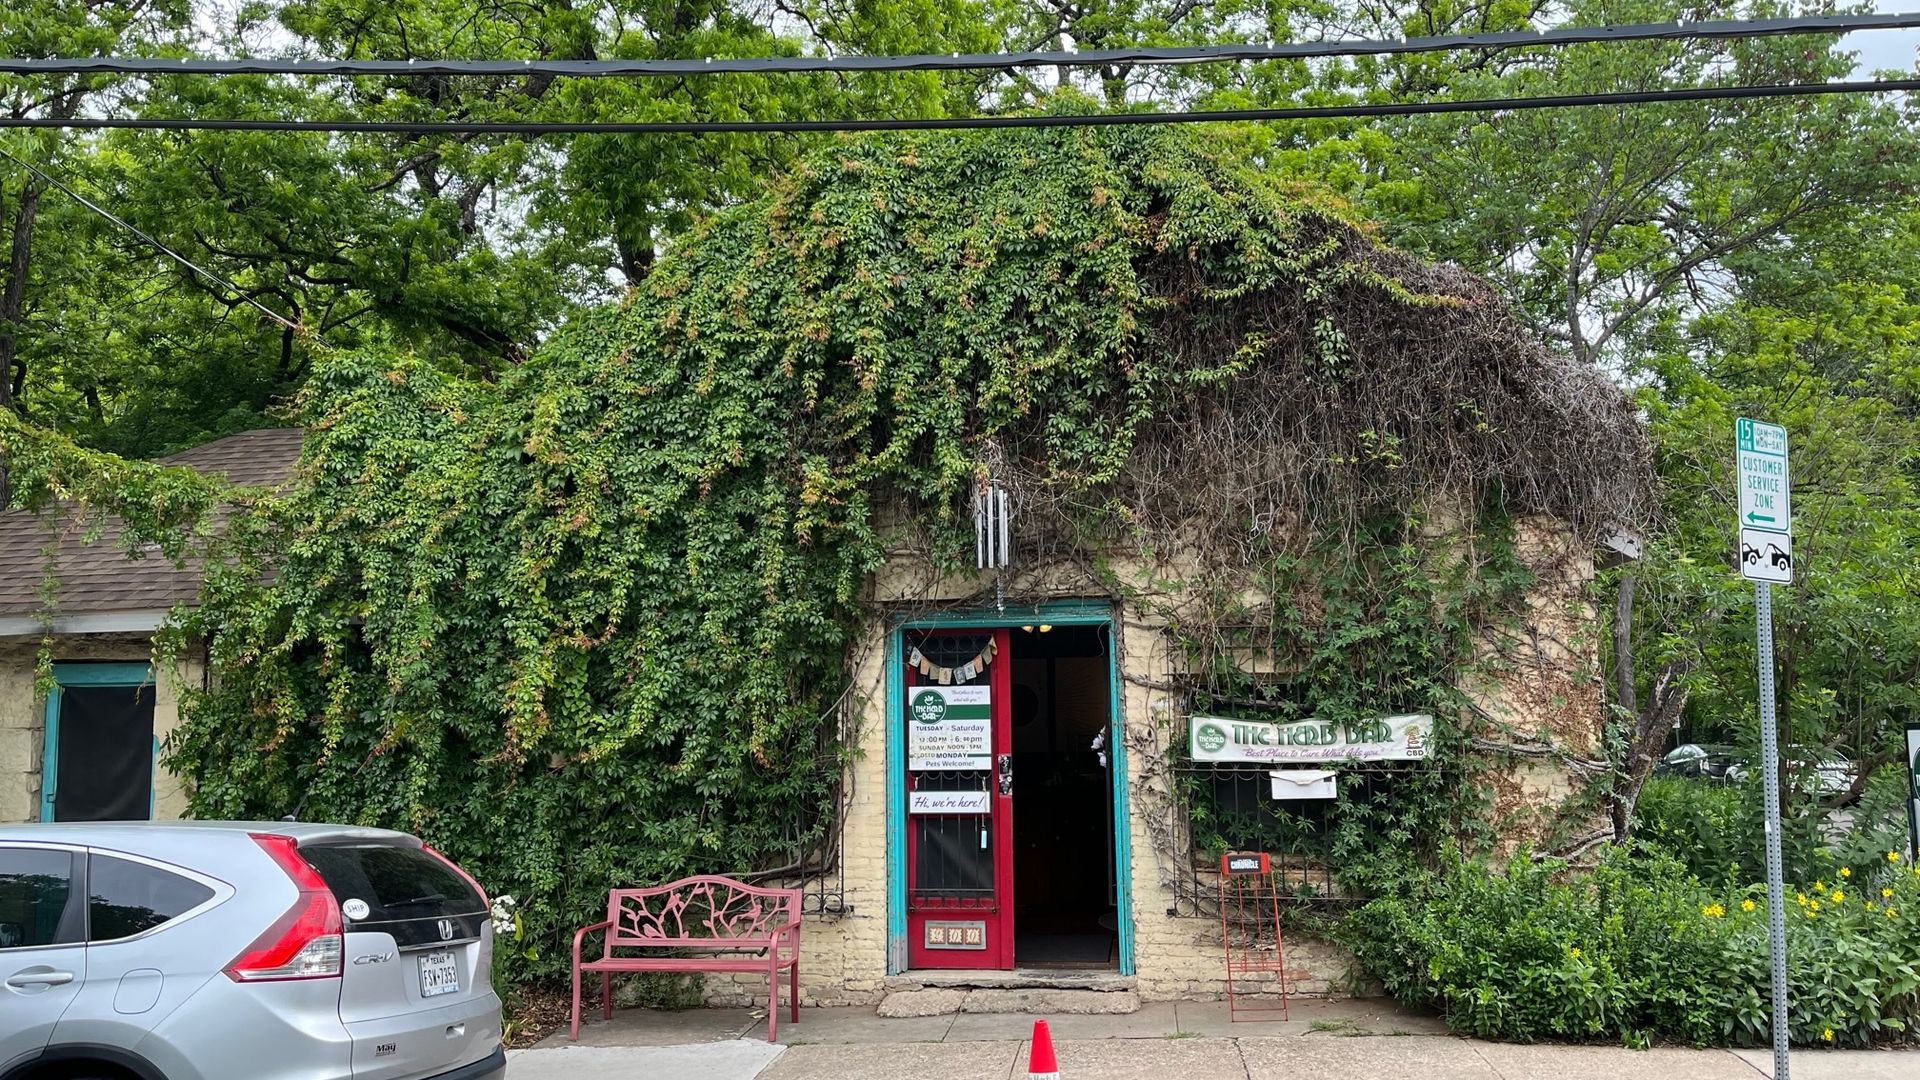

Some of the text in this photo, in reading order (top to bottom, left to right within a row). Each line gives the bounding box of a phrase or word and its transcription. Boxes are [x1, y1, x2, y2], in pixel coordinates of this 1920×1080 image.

[1741, 420, 1751, 439] 15
[1741, 439, 1752, 450] MIN
[1743, 456, 1783, 476] CUSTOMER
[1747, 474, 1779, 493] SERVICE
[1754, 493, 1774, 509] ZONE
[1232, 721, 1394, 746] THE HERB BAR
[1265, 747, 1289, 757] Place
[1300, 748, 1320, 757] Cure
[1321, 747, 1344, 758] What
[914, 796, 985, 808] Hi, we're here!
[1230, 859, 1259, 869] CHRONICLE
[346, 904, 365, 913] SHIP
[353, 952, 394, 966] CR-V
[430, 956, 445, 964] TEXAS
[376, 1043, 396, 1052] May
